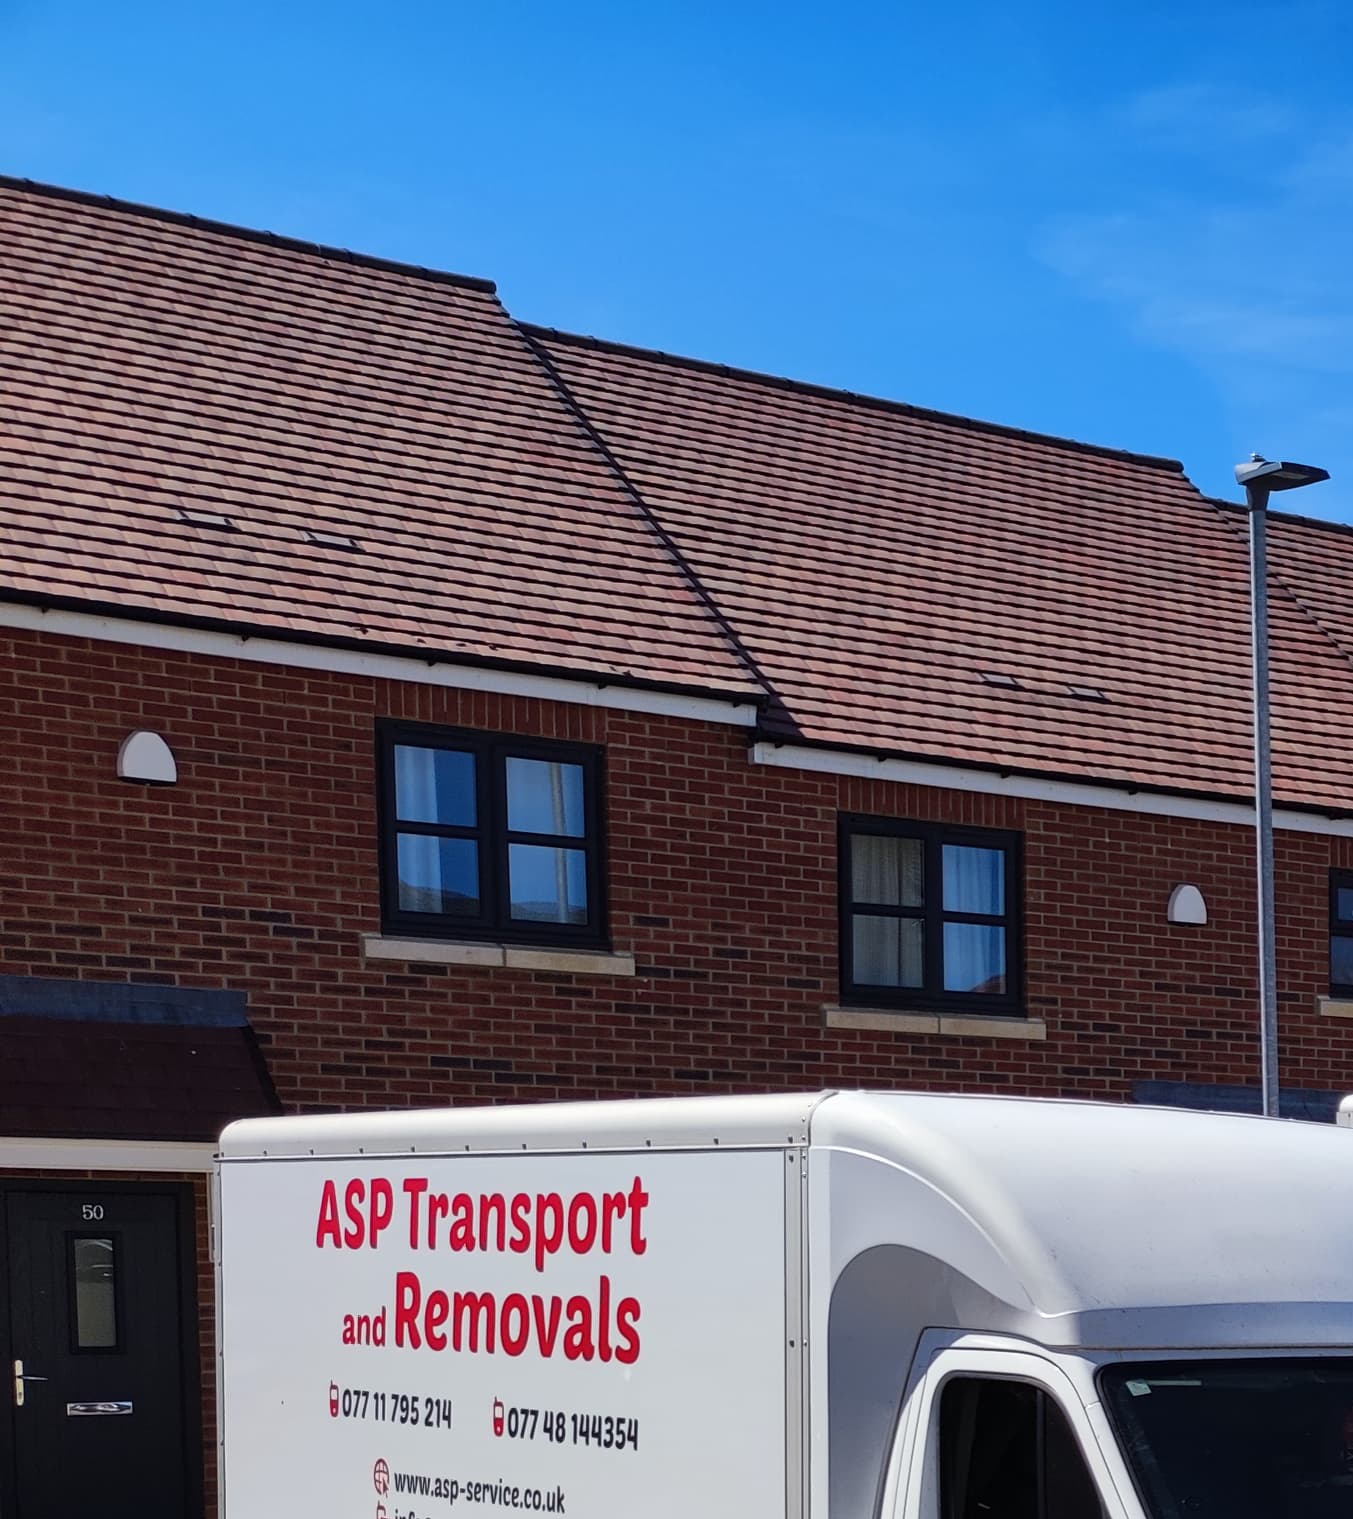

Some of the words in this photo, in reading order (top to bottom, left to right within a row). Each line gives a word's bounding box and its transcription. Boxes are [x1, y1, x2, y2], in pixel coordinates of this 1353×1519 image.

[82, 1205, 104, 1221] 50
[316, 1178, 393, 1249] ASP
[401, 1176, 648, 1272] Transport
[343, 1306, 386, 1346] and
[395, 1271, 640, 1364] Removals
[343, 1389, 369, 1418] 077
[374, 1392, 385, 1421] 11
[392, 1394, 419, 1425] 795
[425, 1398, 451, 1429] 214
[508, 1408, 539, 1440] 077
[543, 1411, 565, 1443] 48
[571, 1414, 638, 1451] 144354
[394, 1472, 565, 1514] www.asp-service.co.uk
